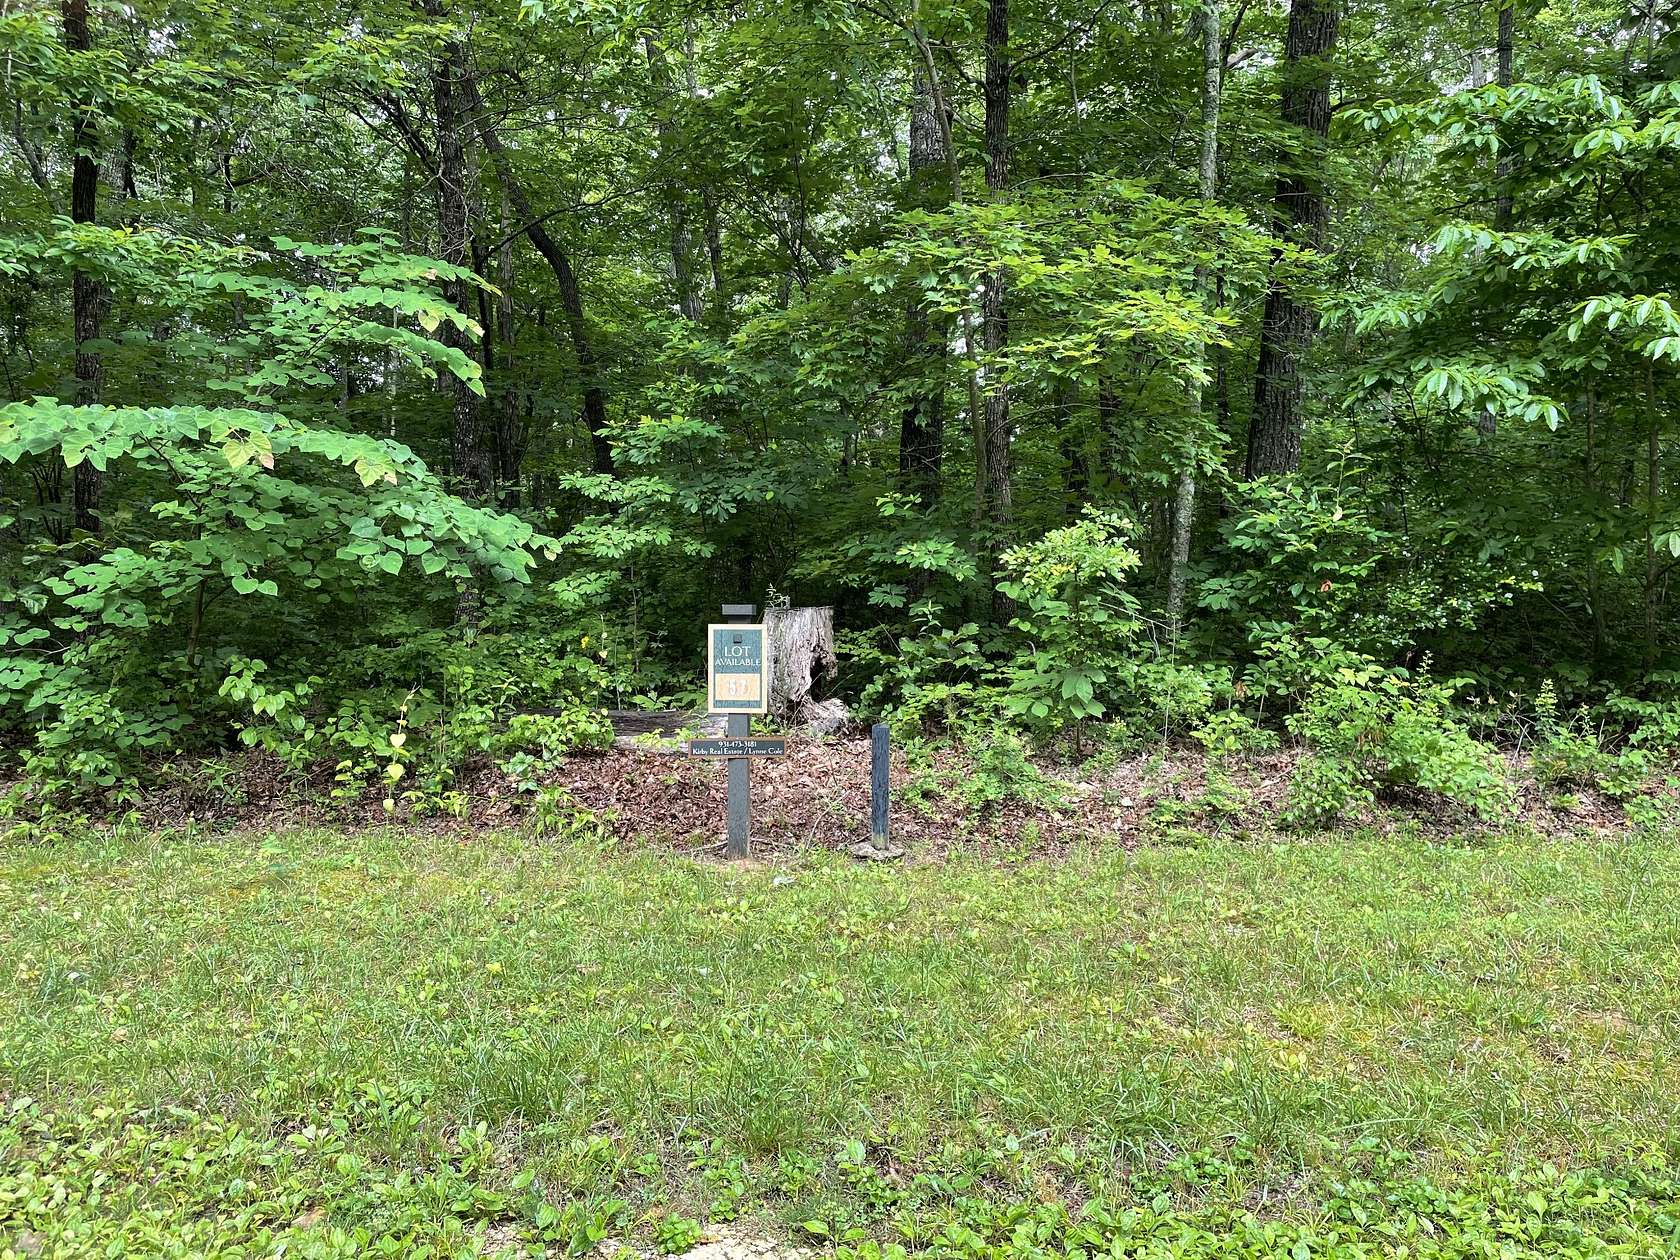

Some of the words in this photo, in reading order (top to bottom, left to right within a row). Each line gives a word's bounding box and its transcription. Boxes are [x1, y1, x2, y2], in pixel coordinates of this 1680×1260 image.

[724, 645, 751, 657] LOT
[714, 658, 762, 666] AVAILABLE
[692, 748, 708, 756] Kirby
[709, 747, 723, 755] Real
[748, 747, 767, 756] Lynne
[767, 747, 783, 755] Cole
